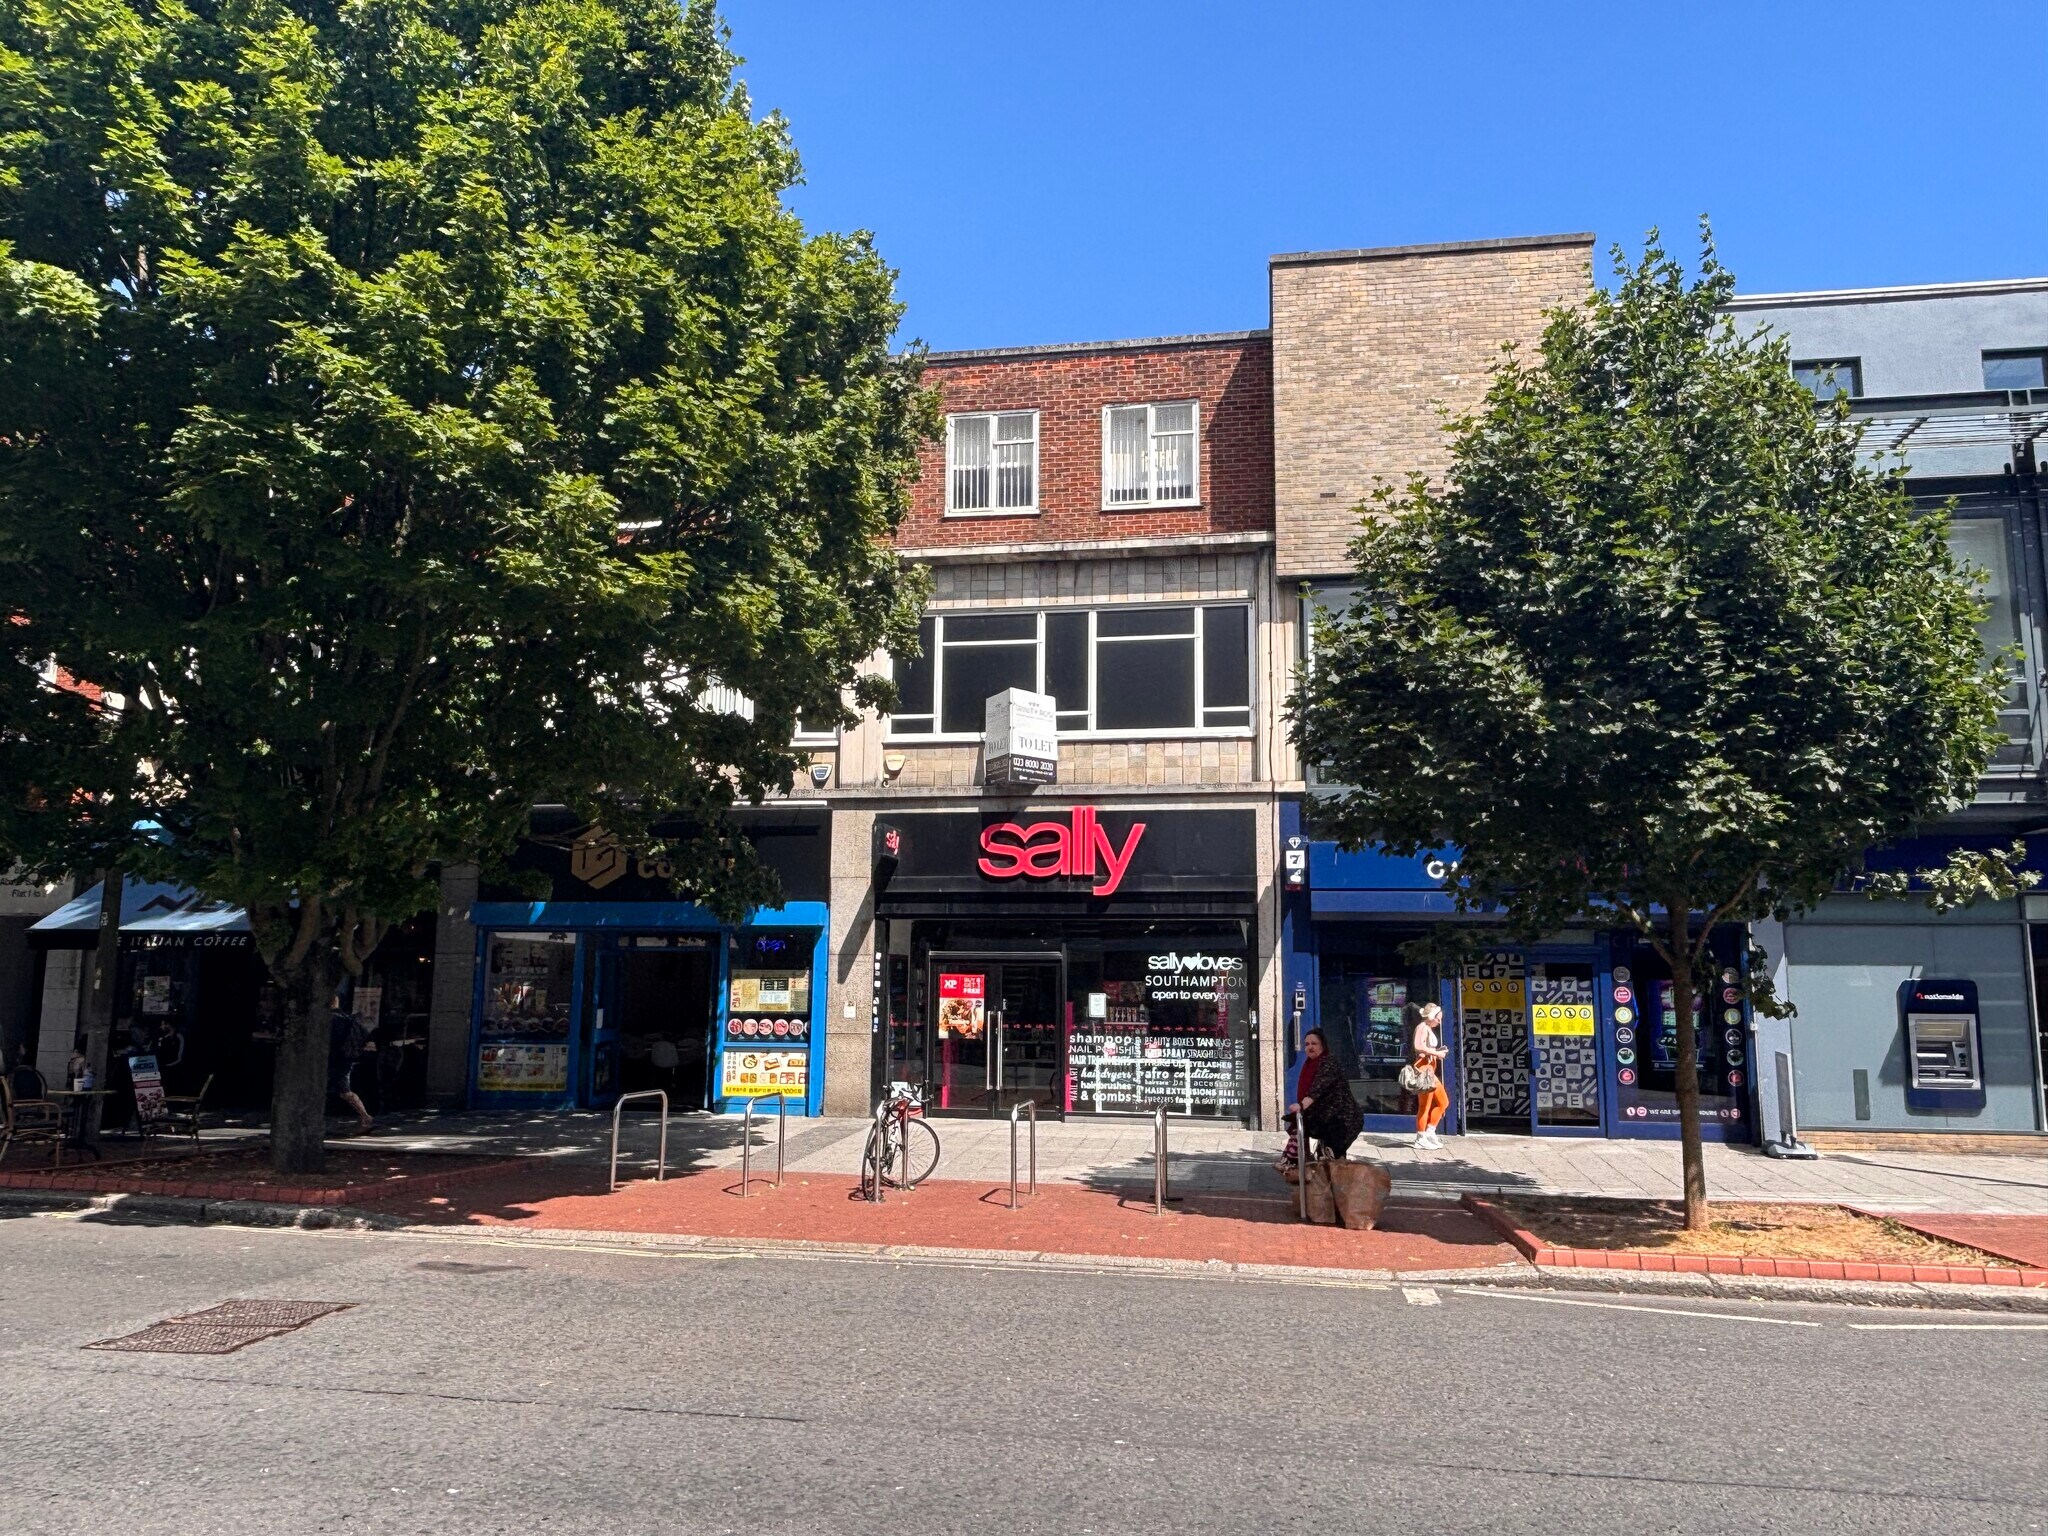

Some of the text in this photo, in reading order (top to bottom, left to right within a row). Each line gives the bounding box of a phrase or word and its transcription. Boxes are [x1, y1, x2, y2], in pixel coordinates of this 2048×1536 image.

[1034, 739, 1053, 753] LET
[977, 805, 1146, 895] sally
[130, 936, 185, 947] ITALIAN
[194, 936, 247, 946] COFFEE
[1148, 952, 1243, 974] sally loves
[1145, 975, 1247, 987] SOUTHAMPTON
[1152, 990, 1239, 1002] open to everyone
[1069, 1033, 1132, 1046] shampoo
[1144, 1036, 1231, 1047] BEAUTY BOXES TANNING
[1069, 1045, 1131, 1055] NAIL PISH
[1069, 1055, 1086, 1064] HAIR
[1145, 1067, 1169, 1079] afro
[1081, 1090, 1089, 1100] &
